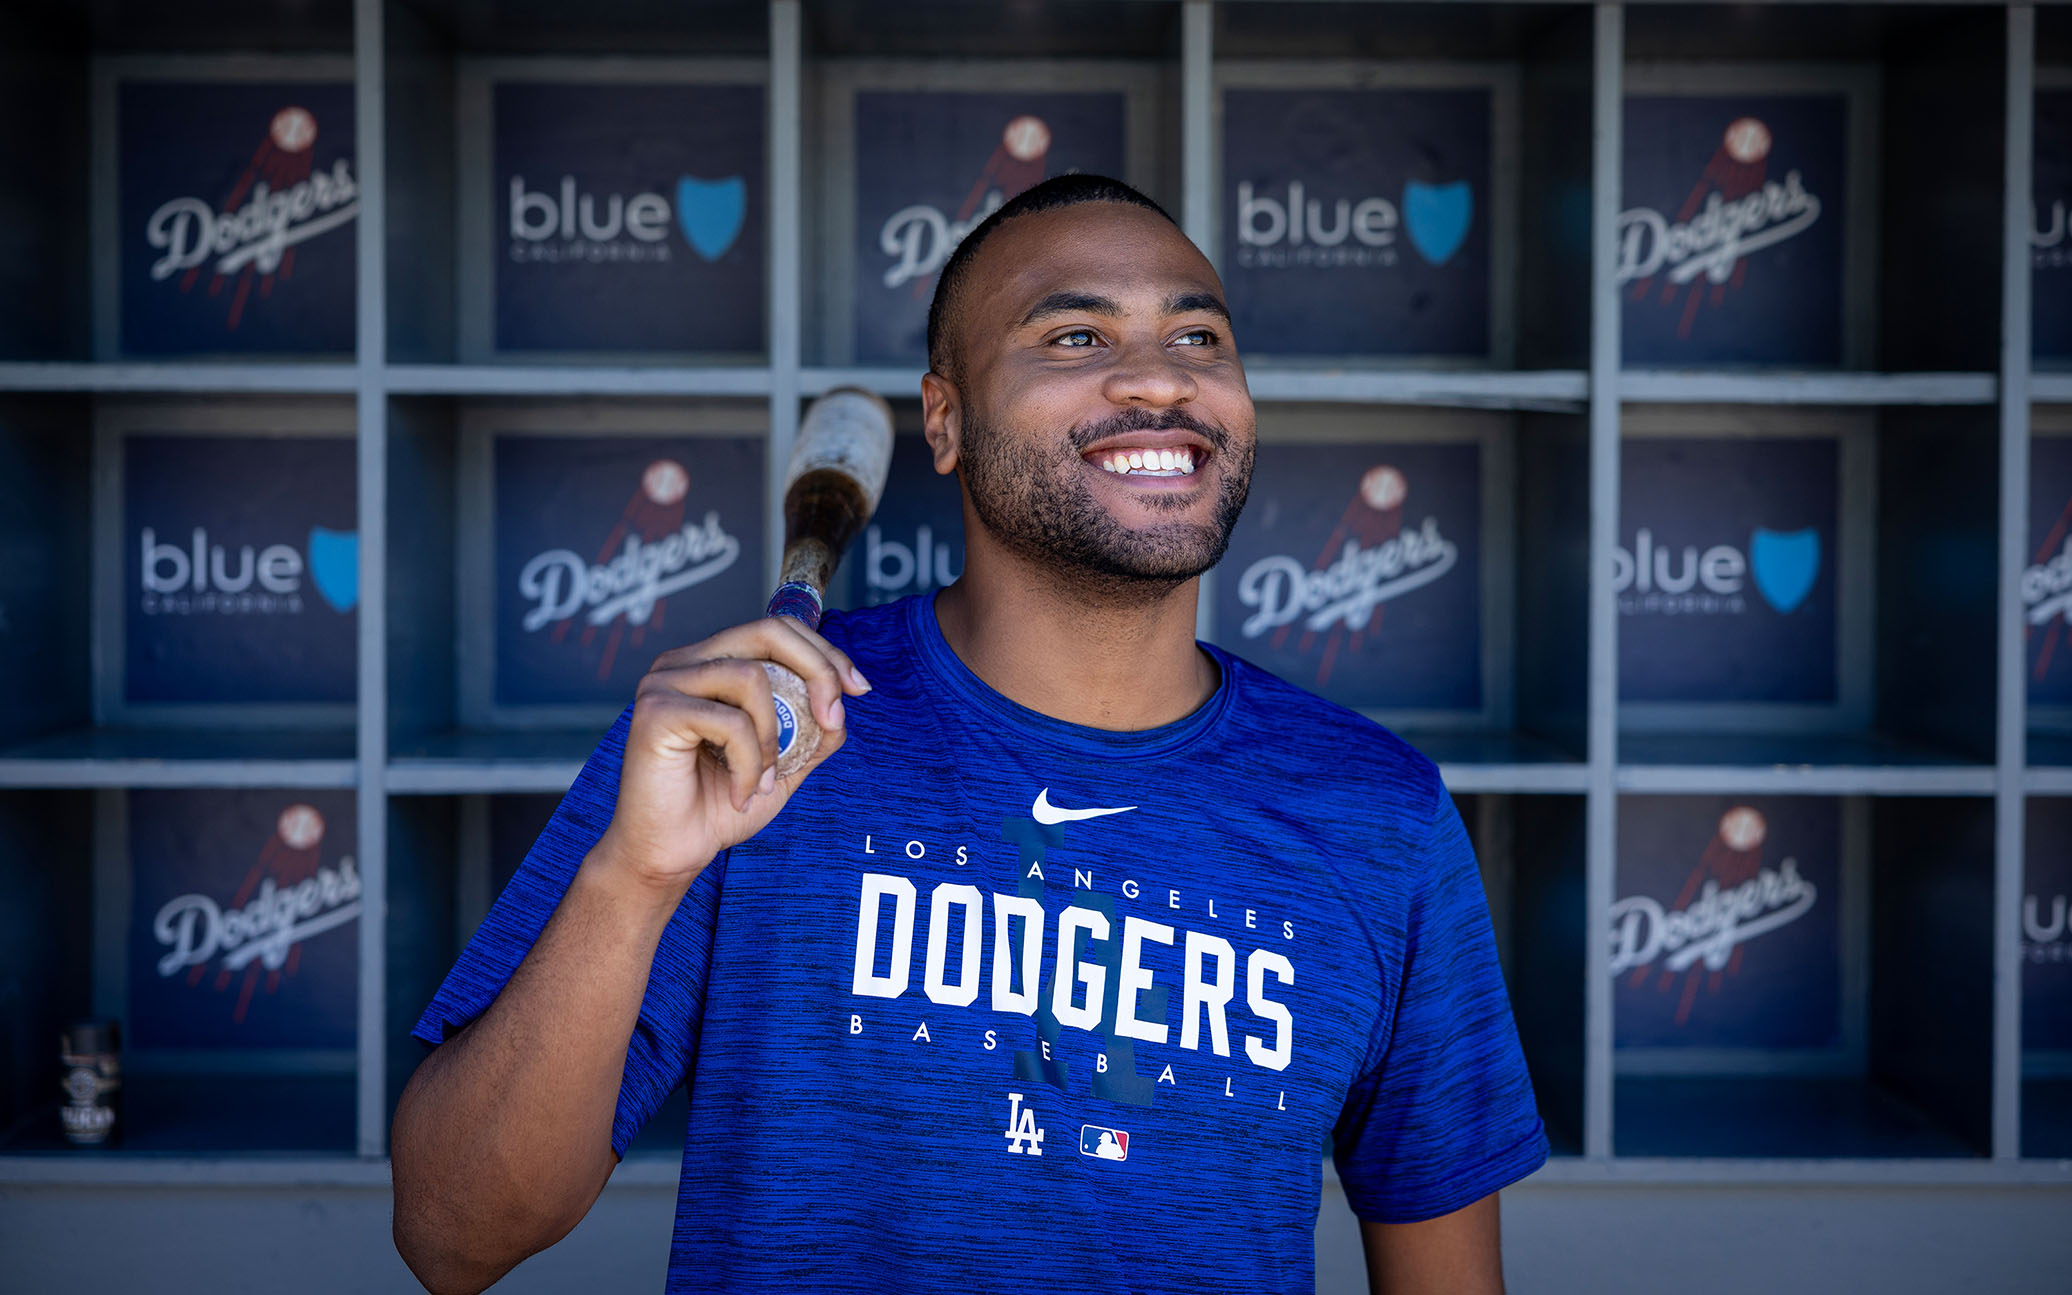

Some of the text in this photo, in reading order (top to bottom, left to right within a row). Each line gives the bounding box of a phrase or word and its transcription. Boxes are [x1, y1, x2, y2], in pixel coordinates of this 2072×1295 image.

[147, 158, 358, 280] Dodgers
[510, 174, 671, 241] blue
[1238, 180, 1398, 246] blue
[1616, 168, 1822, 285] Dodgers
[142, 526, 304, 594] blue
[519, 509, 740, 632] Dodgers
[866, 524, 962, 591] blu
[1238, 516, 1458, 639] Dodgers
[154, 855, 362, 977] Dodgers
[865, 835, 1295, 940] LOS ANGELES
[1608, 855, 1817, 977] Dodgers
[852, 872, 1295, 1072] DODGERS
[849, 1014, 1287, 1112] BASEBALL
[1005, 1093, 1045, 1156] LA
